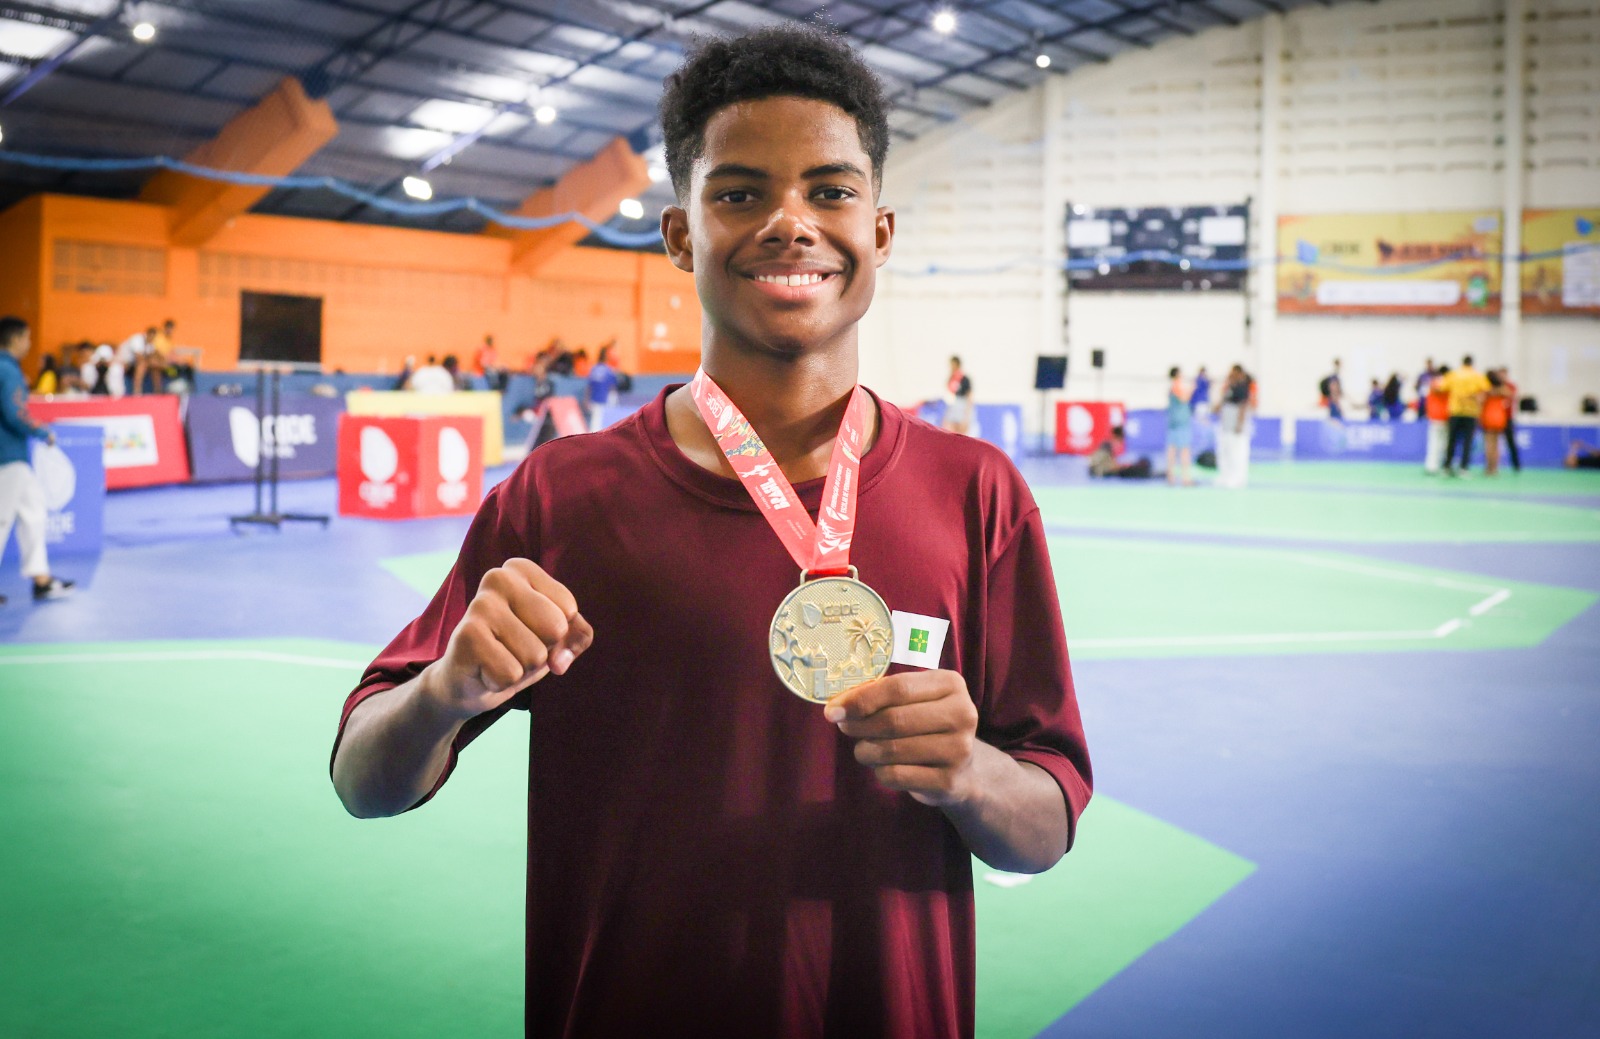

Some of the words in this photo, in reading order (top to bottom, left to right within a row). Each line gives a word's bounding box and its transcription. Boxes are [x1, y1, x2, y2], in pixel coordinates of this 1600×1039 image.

[706, 392, 722, 418] CBDE
[760, 477, 790, 509] BRASIL
[823, 603, 860, 617] CBDE
